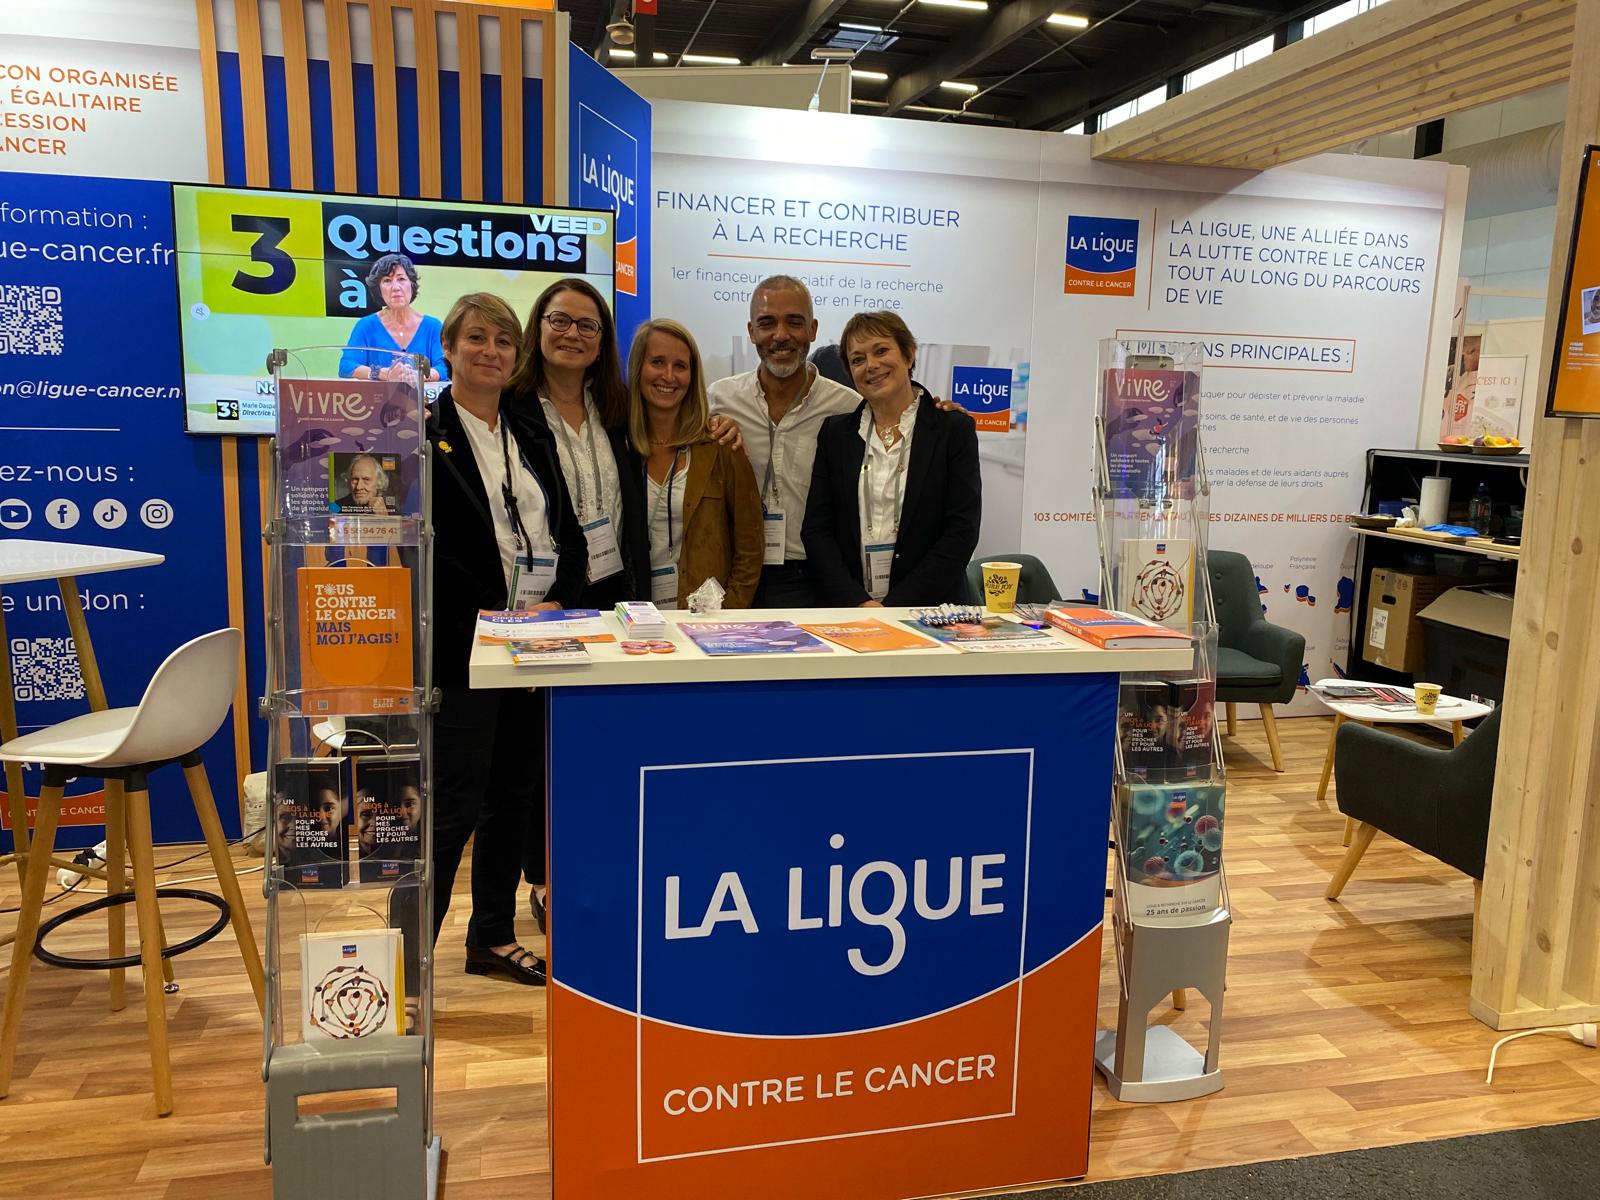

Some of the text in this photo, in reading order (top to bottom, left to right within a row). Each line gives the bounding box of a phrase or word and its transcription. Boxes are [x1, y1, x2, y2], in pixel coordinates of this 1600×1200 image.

[49, 67, 179, 92] ORGANISÉE
[11, 85, 142, 113] ÉGALITAIRE
[0, 112, 86, 133] ESSION
[0, 136, 67, 155] NCER
[583, 152, 598, 188] LA
[1, 202, 133, 229] formation
[657, 190, 960, 228] FINANCER ET CONTRIBUER
[530, 213, 607, 235] VEED
[712, 218, 908, 251] À LA RECHERCHE
[1070, 236, 1087, 250] LA
[1171, 219, 1409, 249] LA LIGUE, UNE ALLIÉE DANS
[231, 213, 582, 295] 3 Questions
[1169, 242, 1425, 272] LA LUTTE CONTRE LE CANCER
[339, 268, 367, 309] à
[672, 267, 944, 293] 1er financeur de la recherche
[1068, 279, 1132, 289] CONTRE LE CANCER
[1168, 265, 1421, 294] TOUT AU LONG DU PARCOURS
[713, 290, 903, 309] contr en France.
[1166, 287, 1223, 305] DE VIE
[1230, 343, 1341, 364] PRINCIPALES
[0, 380, 183, 399] n@ligue-cancer.n
[955, 382, 970, 395] LA
[1200, 391, 1365, 403] uquer pour dépister et prévenir la maladie
[1230, 412, 1242, 421] de
[1268, 414, 1277, 422] et
[1278, 413, 1289, 422] de
[1290, 415, 1302, 423] vie
[1303, 415, 1318, 423] des
[1319, 416, 1359, 425] personnes
[1209, 446, 1250, 454] recherche
[0, 465, 118, 482] ez-nous
[1216, 468, 1249, 476] malades
[1273, 469, 1292, 477] leurs
[1293, 469, 1322, 477] aidants
[1226, 478, 1234, 486] la
[1236, 478, 1267, 487] défense
[1268, 479, 1279, 487] de
[1301, 479, 1323, 488] droits
[1033, 512, 1050, 522] 103
[1224, 513, 1269, 522] DIZAINES
[1271, 513, 1284, 522] DE
[1286, 513, 1328, 523] MILLIERS
[1330, 514, 1343, 523] DE
[26, 595, 61, 612] un
[79, 589, 129, 611] don
[315, 596, 377, 608] CONTRE
[315, 608, 397, 621] LE CANCER
[316, 622, 351, 633] MAIS
[316, 634, 346, 645] MOI
[69, 805, 106, 815] CANCE
[390, 835, 419, 843] AUTRES
[665, 871, 759, 940] LA
[1180, 904, 1206, 914] passion
[663, 1054, 996, 1116] CONTRE LE CANCER
